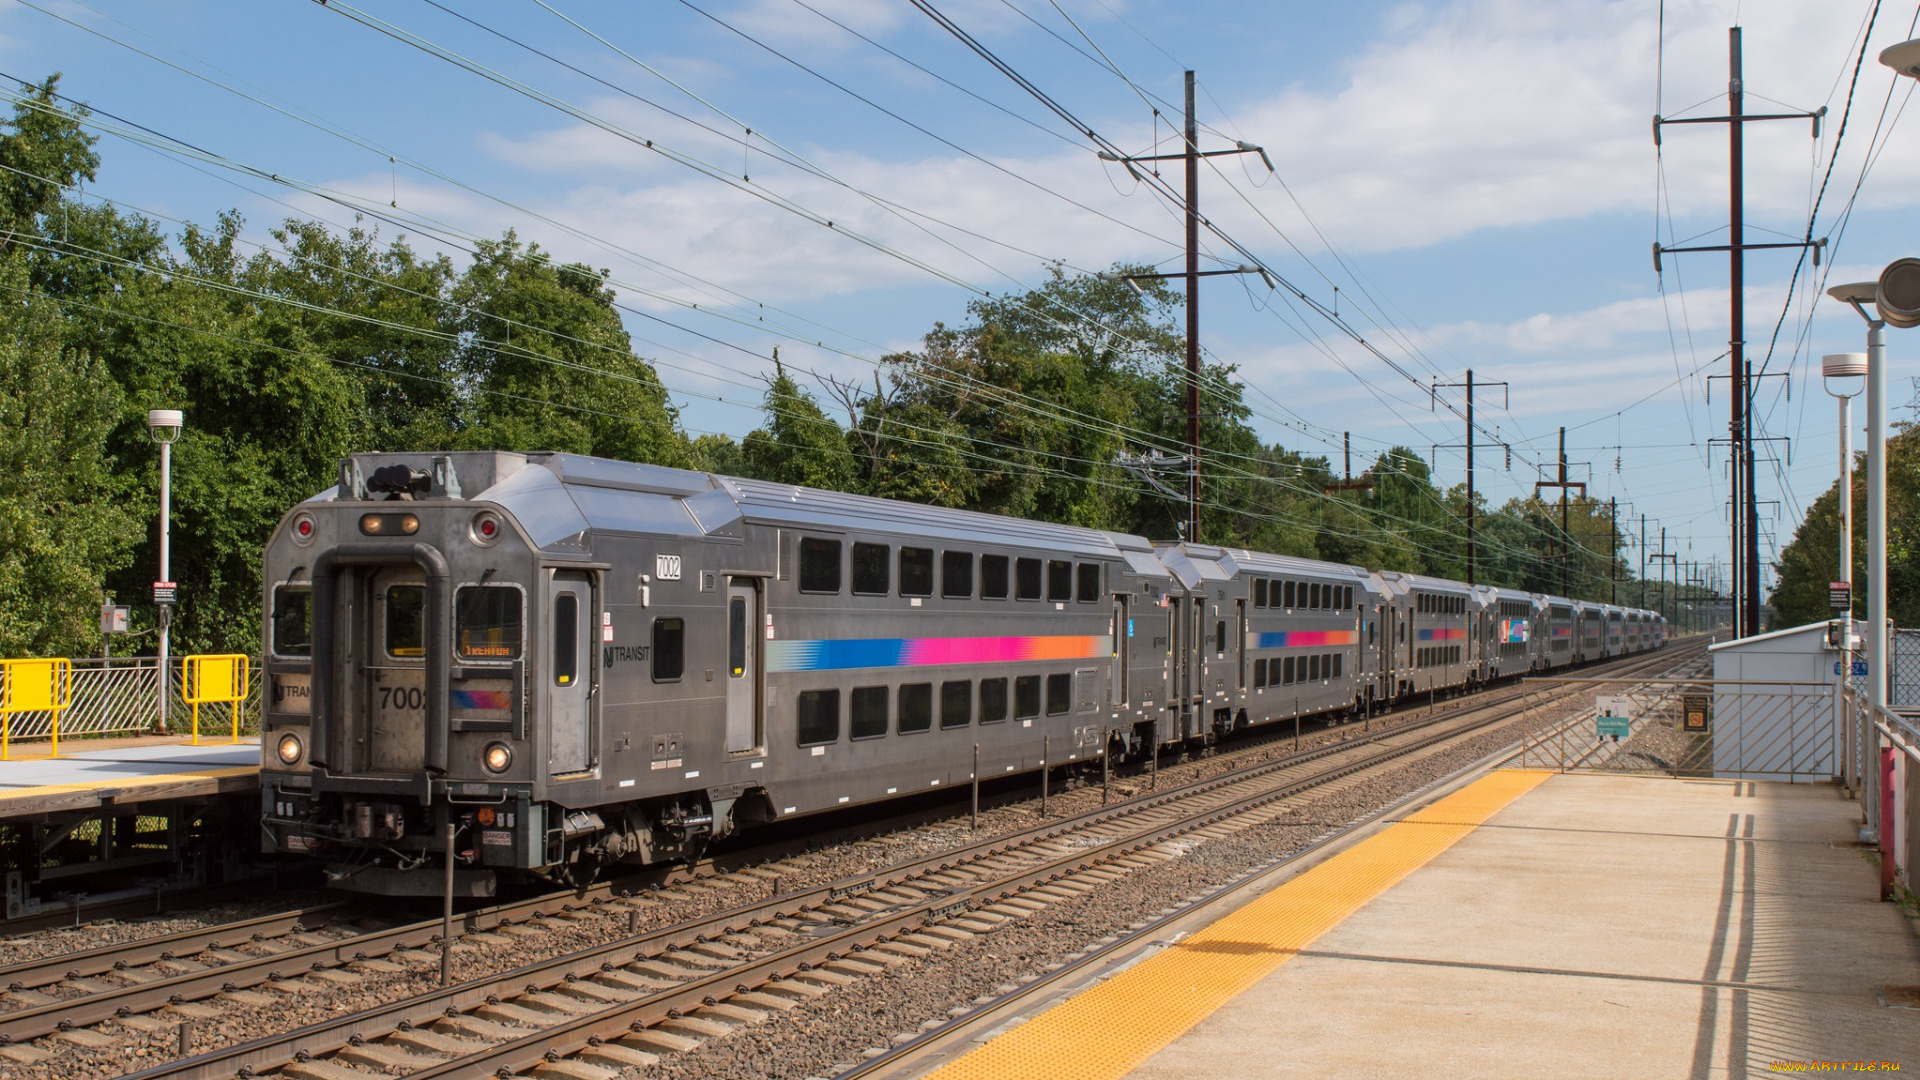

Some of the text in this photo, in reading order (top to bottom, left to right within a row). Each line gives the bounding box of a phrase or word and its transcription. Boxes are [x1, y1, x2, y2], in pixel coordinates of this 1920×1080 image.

[658, 557, 679, 577] 7002
[615, 646, 650, 661] TRANSIT
[286, 685, 312, 697] TRAN
